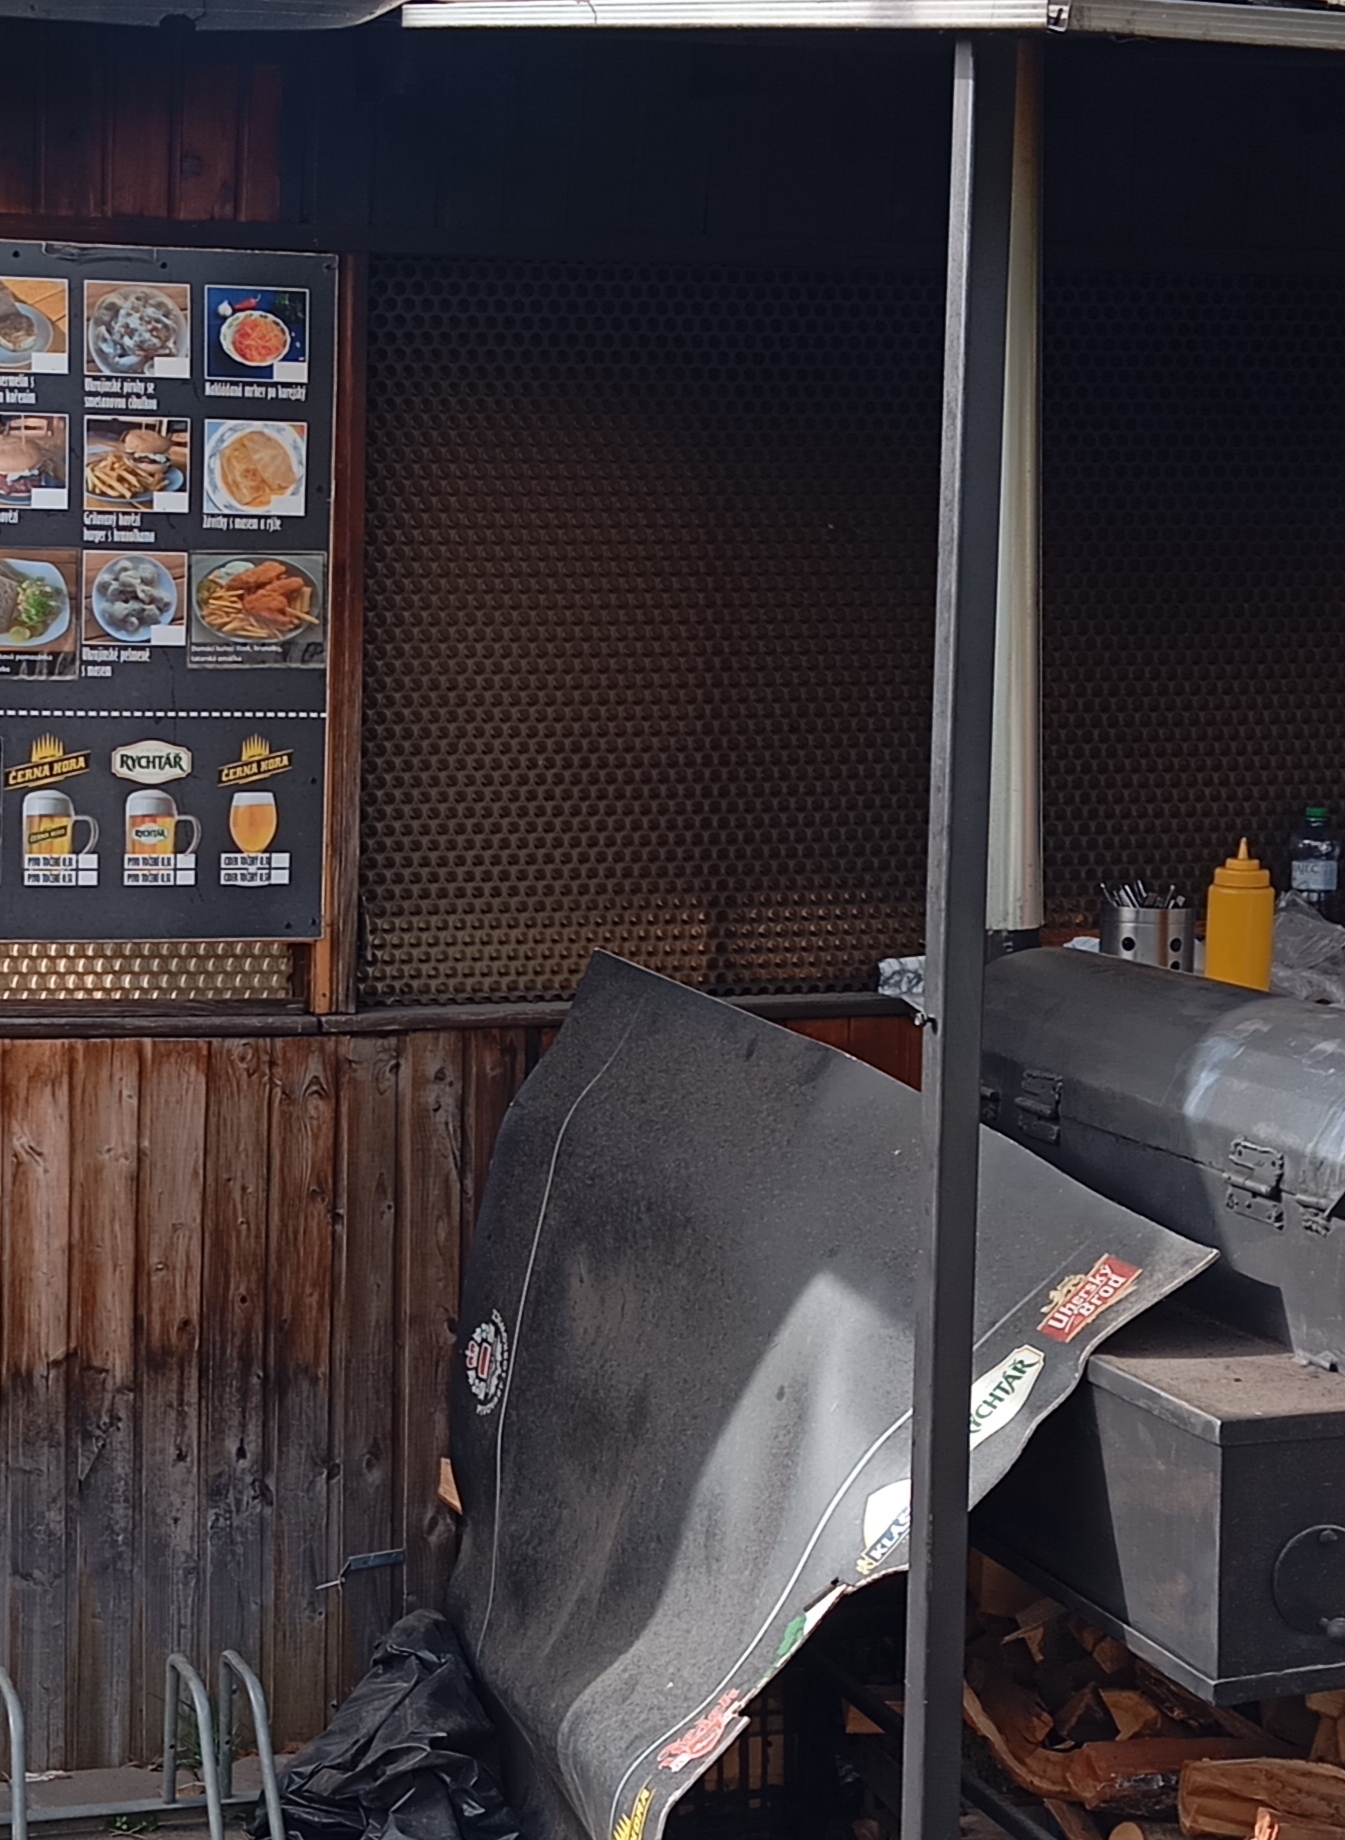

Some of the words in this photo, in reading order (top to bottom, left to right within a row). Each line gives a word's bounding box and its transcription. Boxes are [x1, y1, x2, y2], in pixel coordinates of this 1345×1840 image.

[30, 377, 35, 388] s
[52, 756, 86, 776] HORA
[119, 750, 187, 773] RYCHTÁŘ
[260, 755, 290, 773] HORA
[1078, 1273, 1127, 1317] Brod
